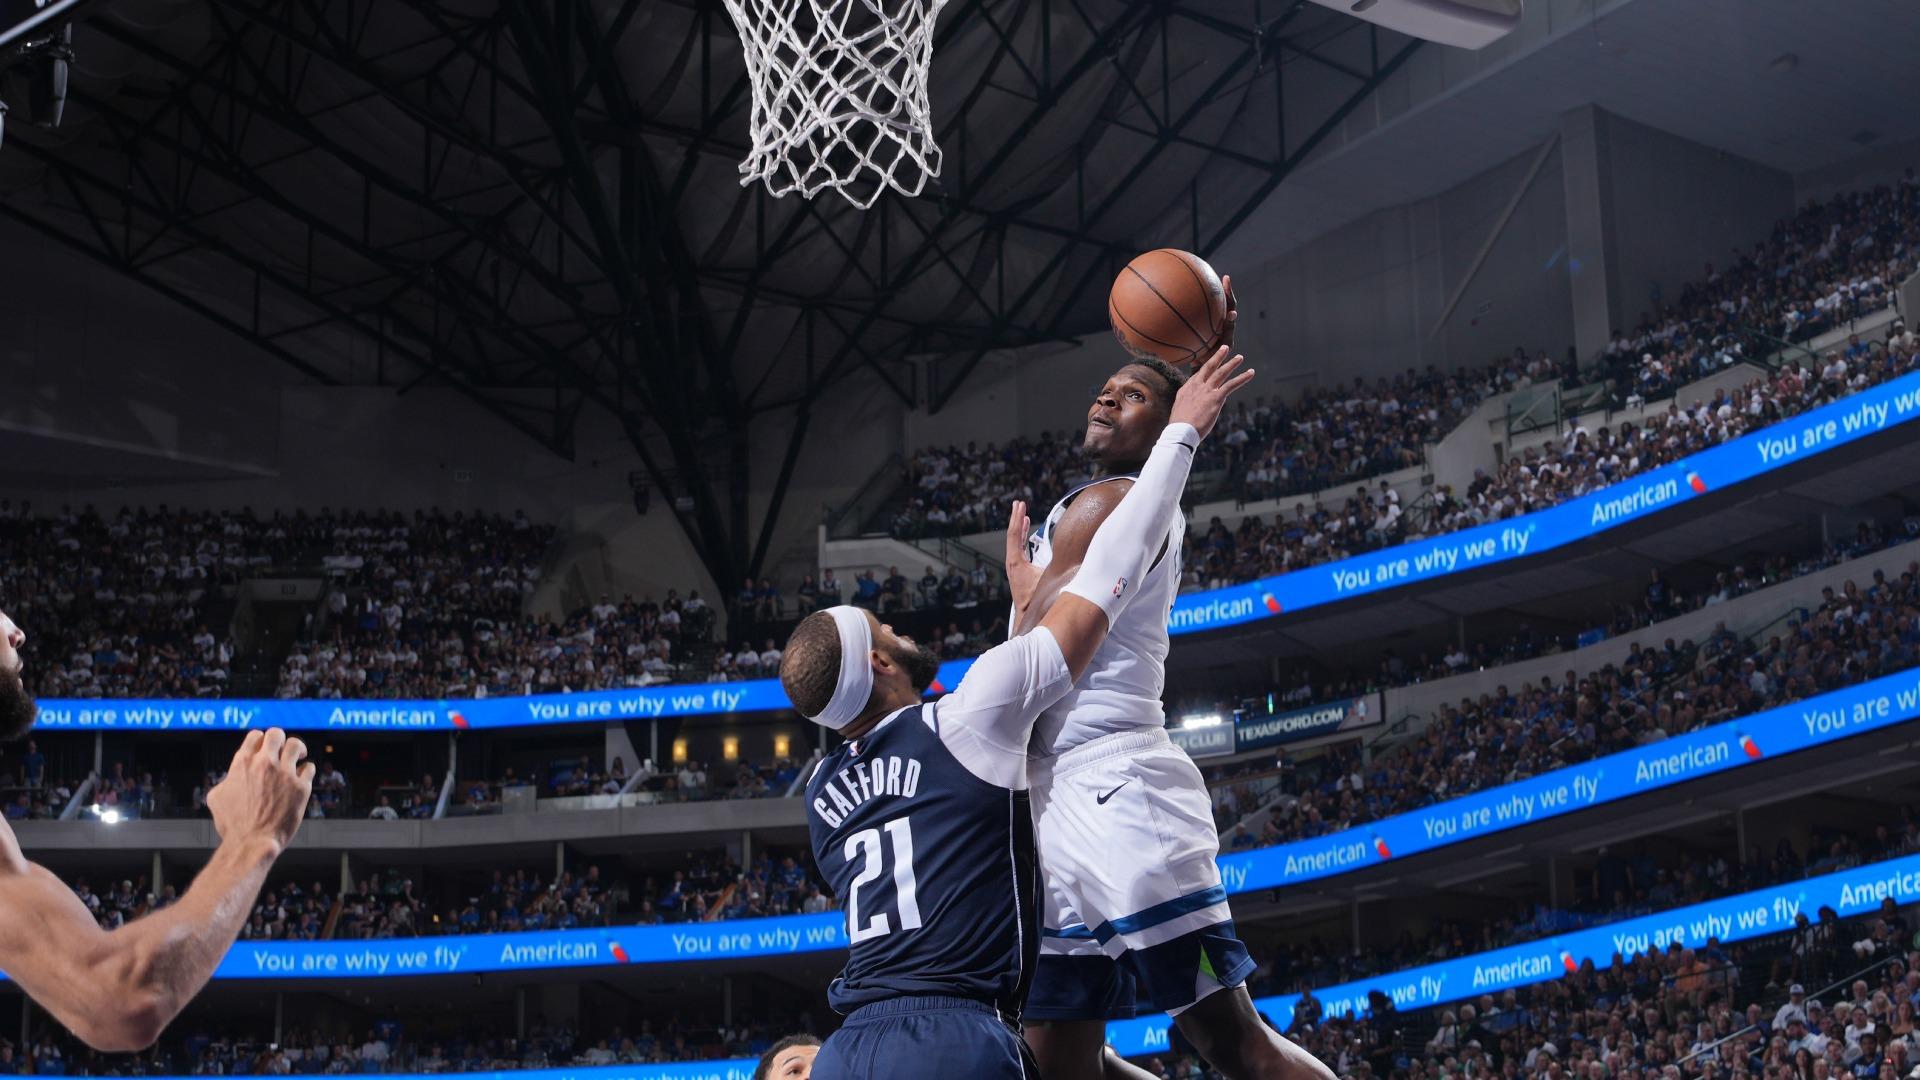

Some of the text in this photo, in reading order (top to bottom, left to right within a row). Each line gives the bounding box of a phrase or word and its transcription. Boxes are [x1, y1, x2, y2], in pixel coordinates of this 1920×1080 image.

[1758, 435, 1797, 462] You
[1803, 420, 1837, 449] are
[1842, 401, 1889, 432] why
[1592, 479, 1678, 525] American
[1332, 529, 1529, 591] You are why we fly
[78, 710, 117, 725] are
[124, 707, 174, 729] why
[181, 710, 216, 725] we
[223, 706, 252, 729] fly
[329, 707, 436, 725] American
[529, 690, 740, 719] You are why we fly
[1803, 697, 1890, 736] You are
[1238, 707, 1343, 741] TEXASFORD.COM
[1189, 733, 1226, 748] CLUB
[1636, 742, 1728, 782] American
[814, 756, 922, 829] GAFFORD
[1424, 777, 1597, 838] You are why we fly
[1285, 843, 1366, 874] American
[843, 816, 922, 944] 21
[1222, 865, 1247, 890] fly
[1839, 872, 1920, 908] America
[673, 935, 711, 951] You
[718, 935, 752, 950] are
[758, 929, 800, 949] why
[807, 927, 836, 943] we
[1613, 897, 1800, 955] You are why we fly
[255, 947, 460, 971] You are why we fly
[501, 943, 597, 961] American
[1473, 955, 1552, 986] American
[1392, 985, 1417, 1004] we
[1420, 977, 1442, 1000] fly
